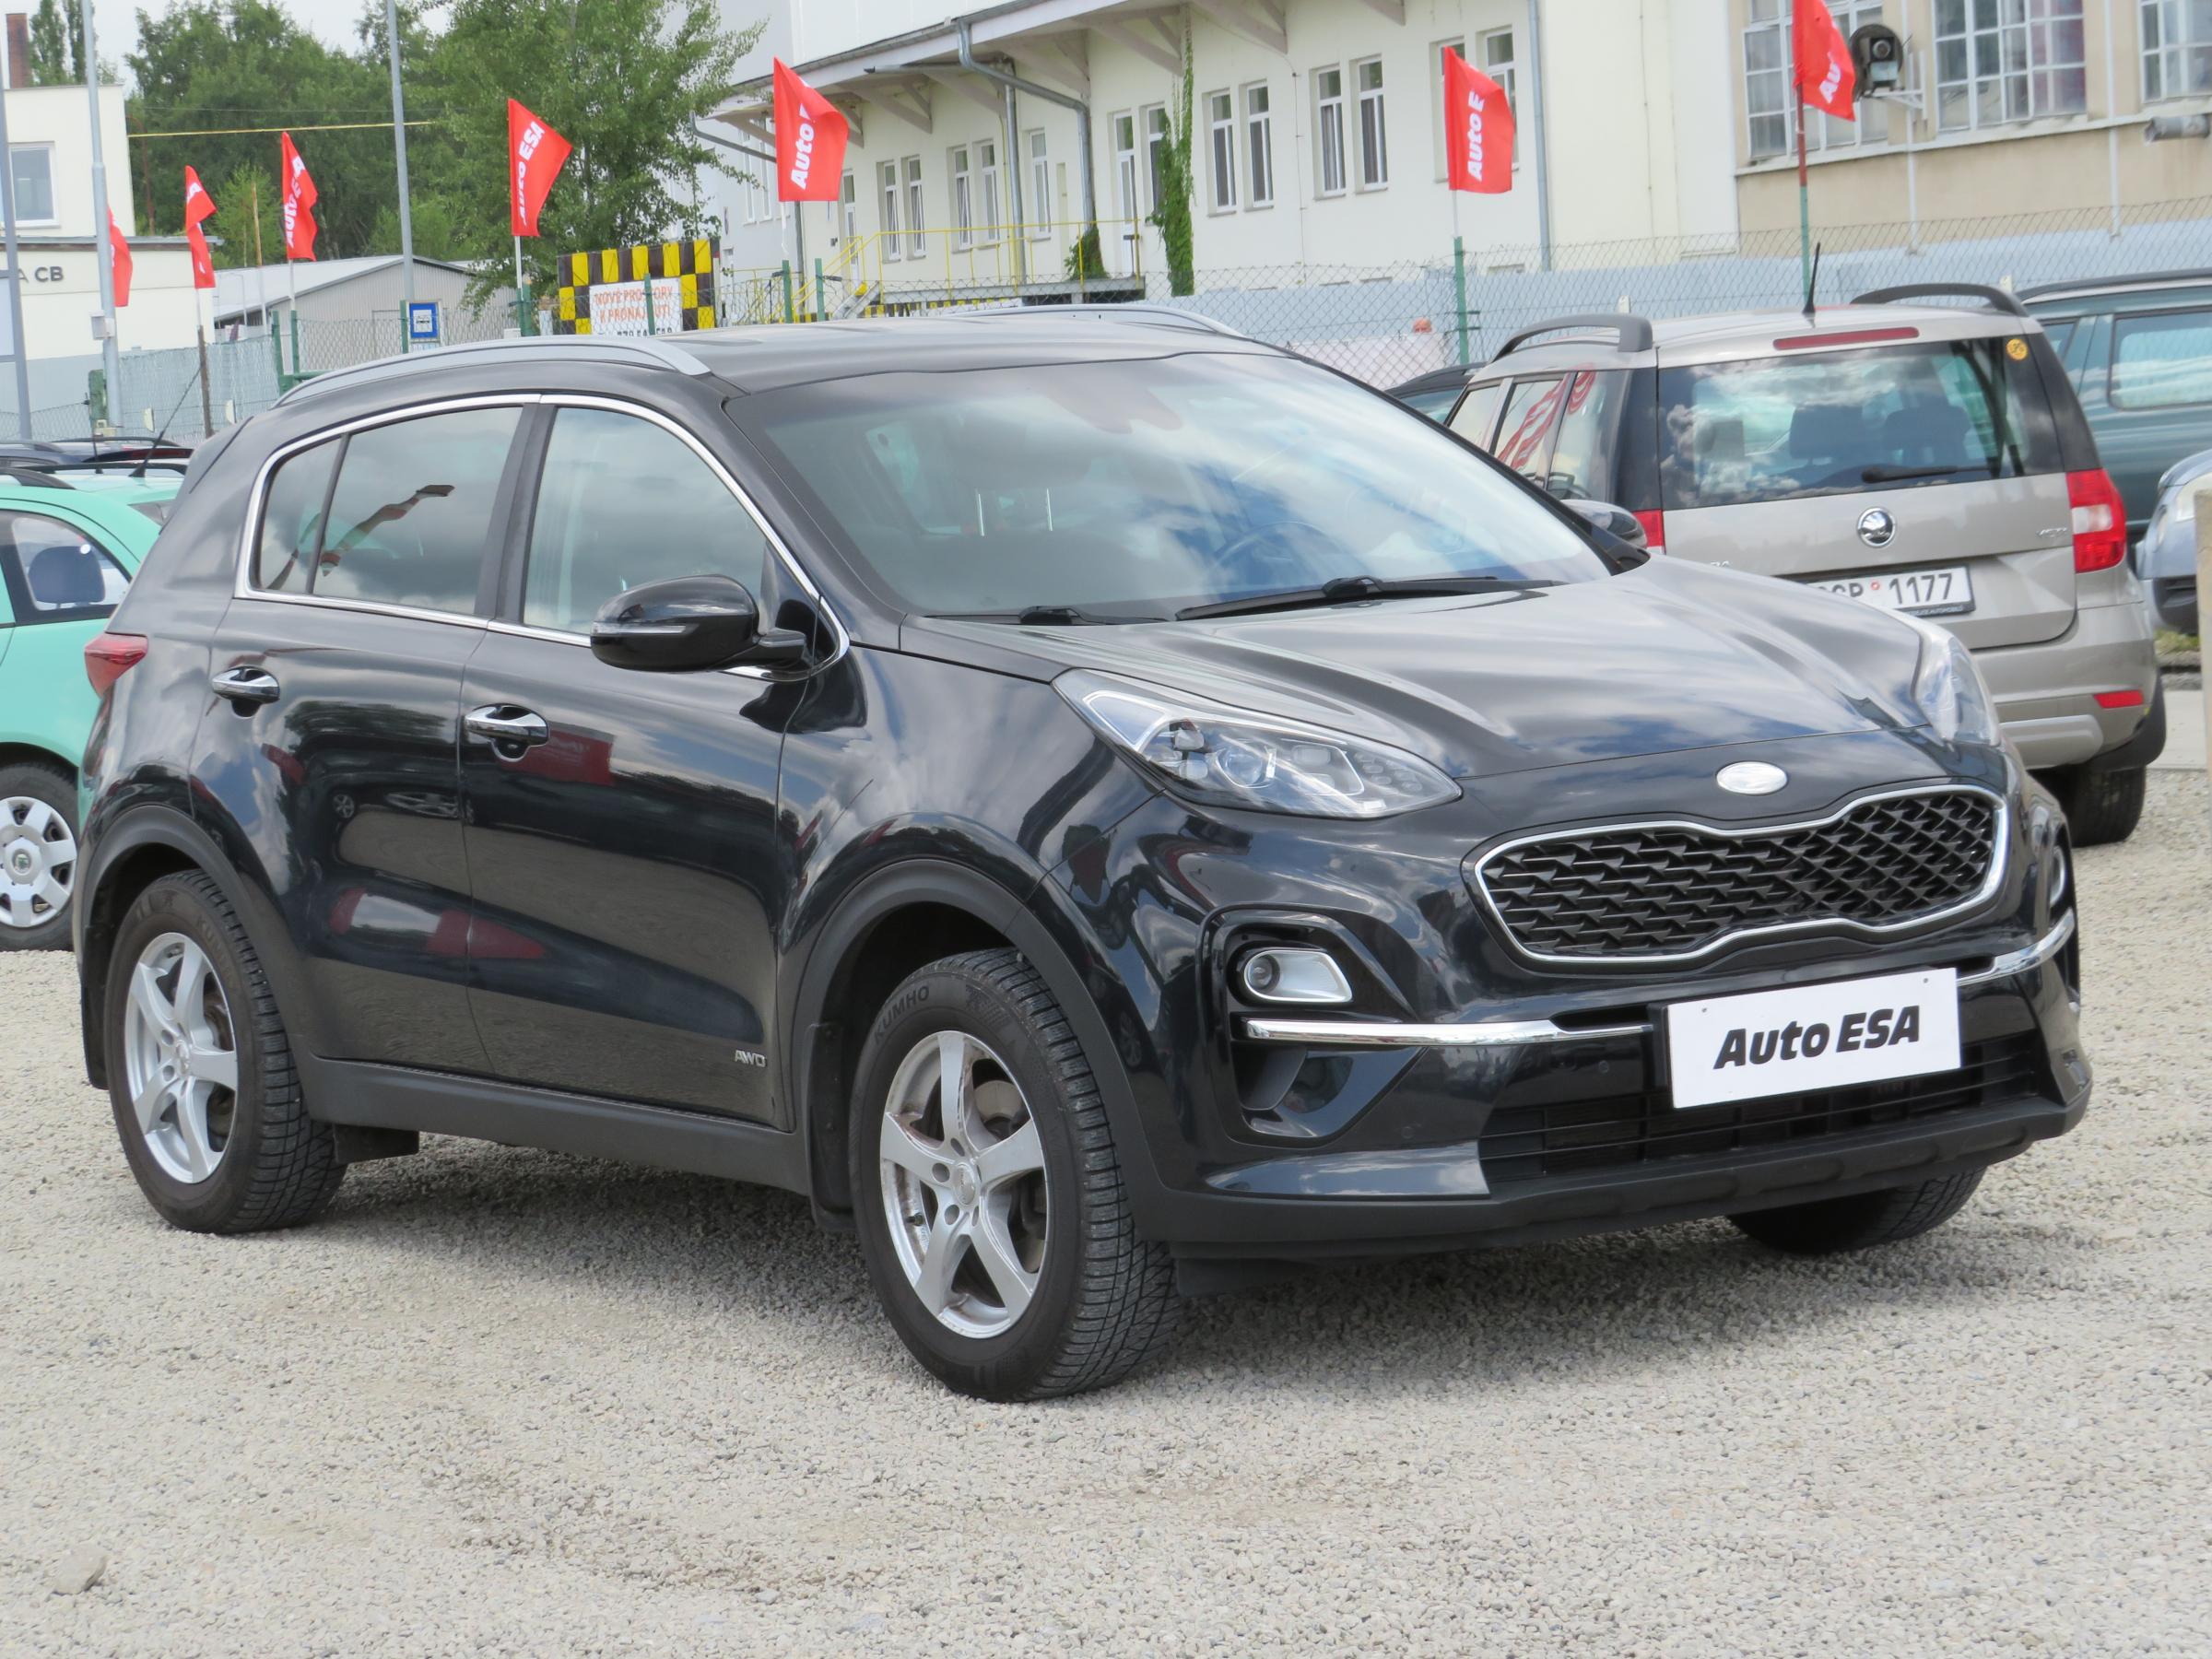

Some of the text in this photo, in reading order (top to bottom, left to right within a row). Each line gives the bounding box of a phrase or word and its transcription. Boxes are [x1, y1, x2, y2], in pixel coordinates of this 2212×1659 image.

[519, 121, 545, 161] ESA
[791, 123, 815, 190] Auto
[1467, 112, 1483, 182] Auto
[35, 266, 65, 283] CB
[624, 286, 673, 301] PROORY
[1889, 573, 1952, 605] 1177
[874, 985, 930, 1045] KUMHO
[1712, 1005, 1920, 1070] Auto ESA
[735, 1049, 766, 1068] AWD
